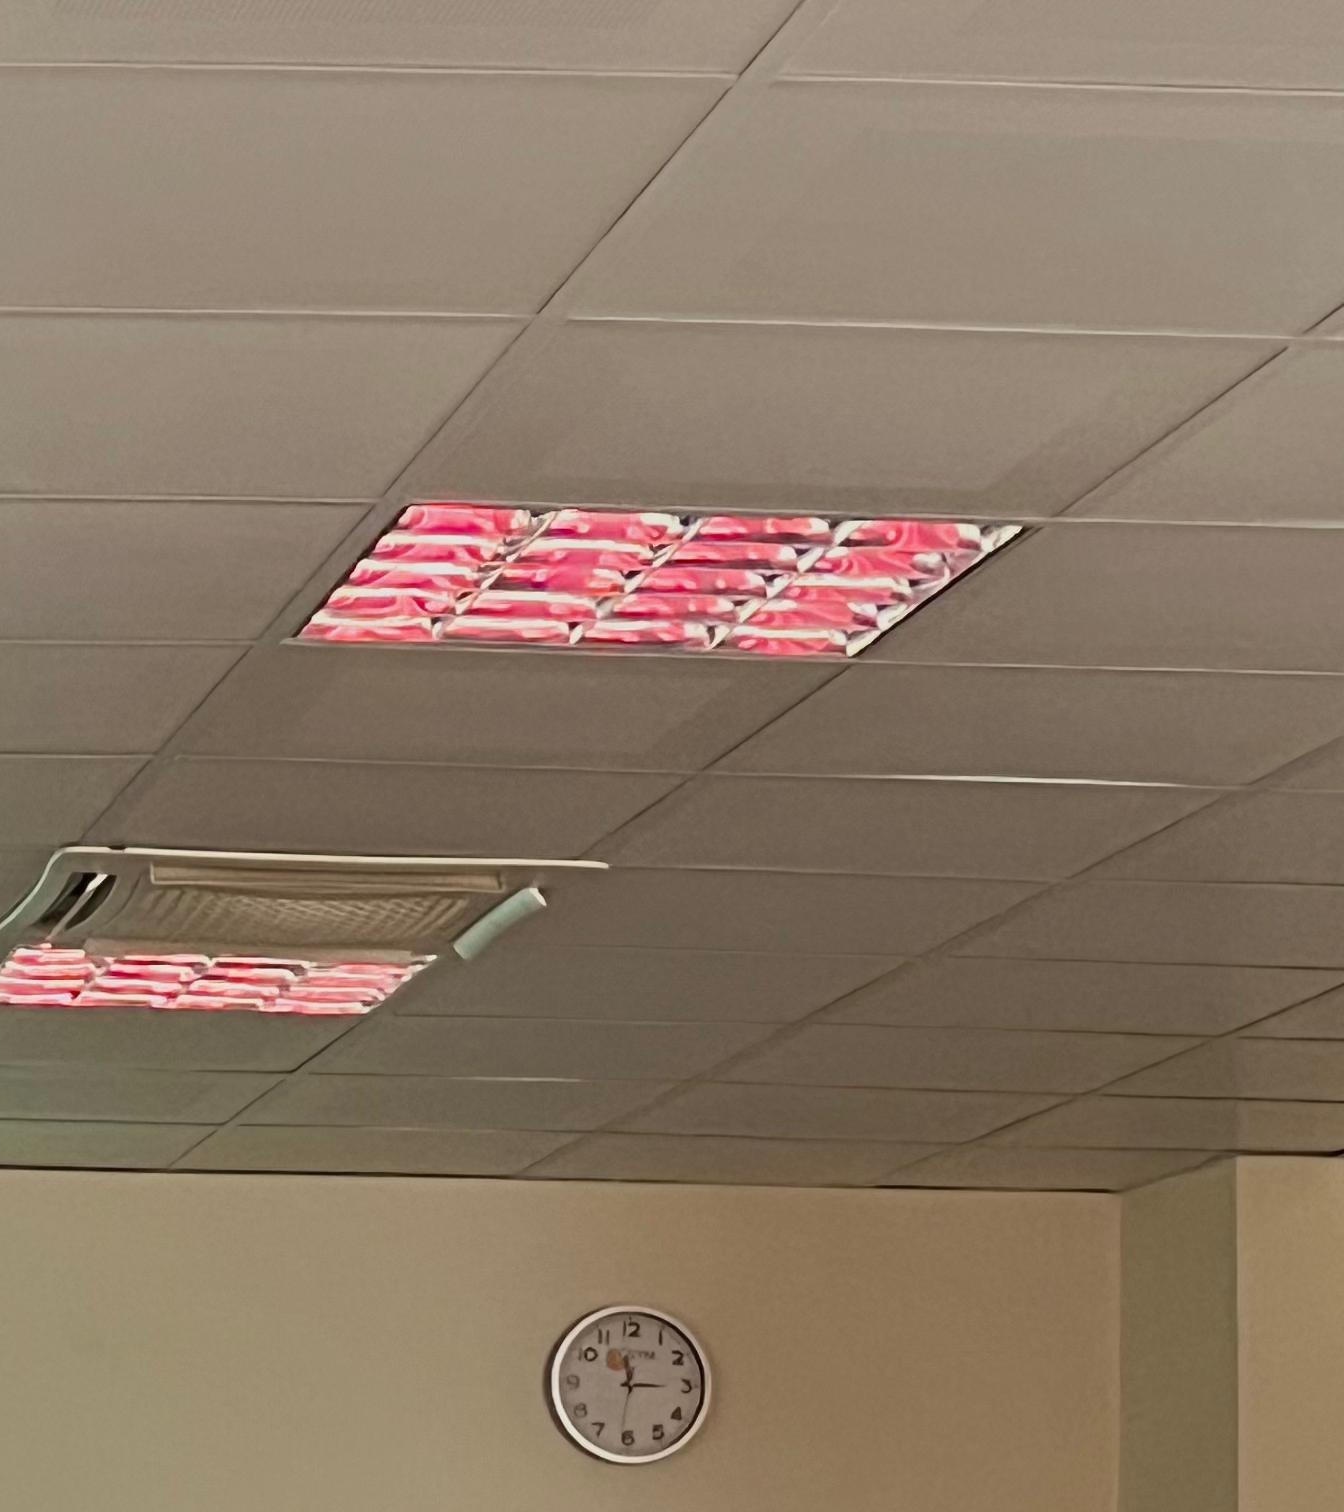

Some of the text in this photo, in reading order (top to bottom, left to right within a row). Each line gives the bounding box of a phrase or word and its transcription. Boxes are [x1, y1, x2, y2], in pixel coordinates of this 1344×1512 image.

[598, 1328, 610, 1345] 11
[622, 1319, 641, 1338] 12
[658, 1330, 663, 1346] 1
[578, 1347, 598, 1362] 10
[672, 1350, 684, 1366] 2
[566, 1374, 581, 1390] 9
[681, 1378, 692, 1394] 3
[573, 1402, 588, 1418] 8
[670, 1406, 683, 1421] 4
[591, 1421, 605, 1438] 7
[652, 1424, 665, 1441] 5
[621, 1430, 635, 1446] 6
